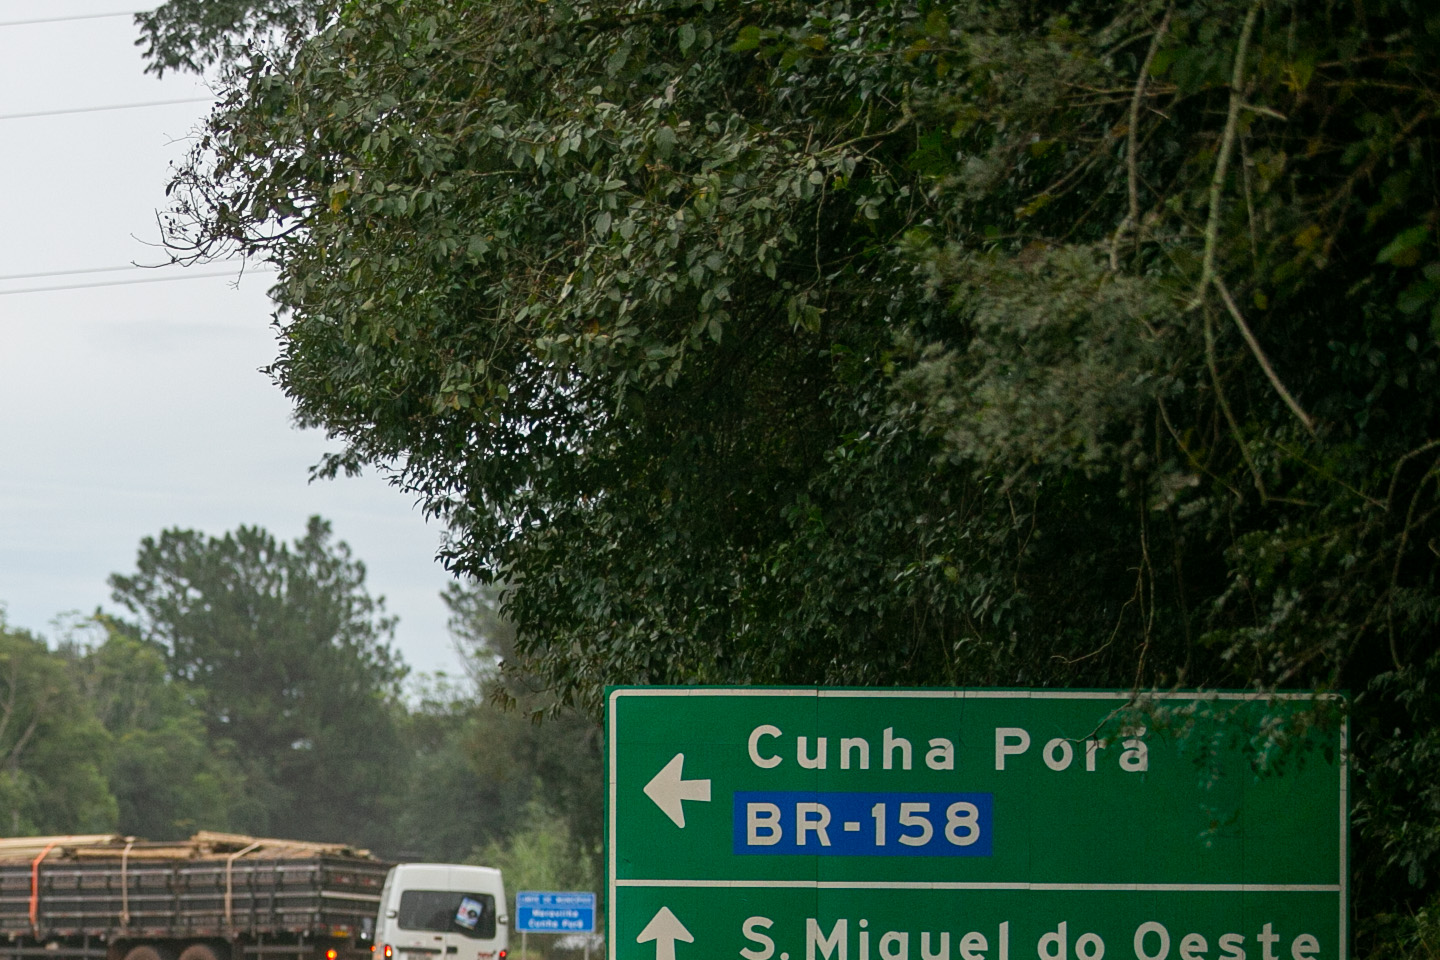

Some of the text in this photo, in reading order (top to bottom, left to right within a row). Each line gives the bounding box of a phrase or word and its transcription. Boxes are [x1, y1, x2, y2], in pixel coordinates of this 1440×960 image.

[747, 724, 1149, 772] Cunha Porã
[746, 801, 981, 847] BR-158
